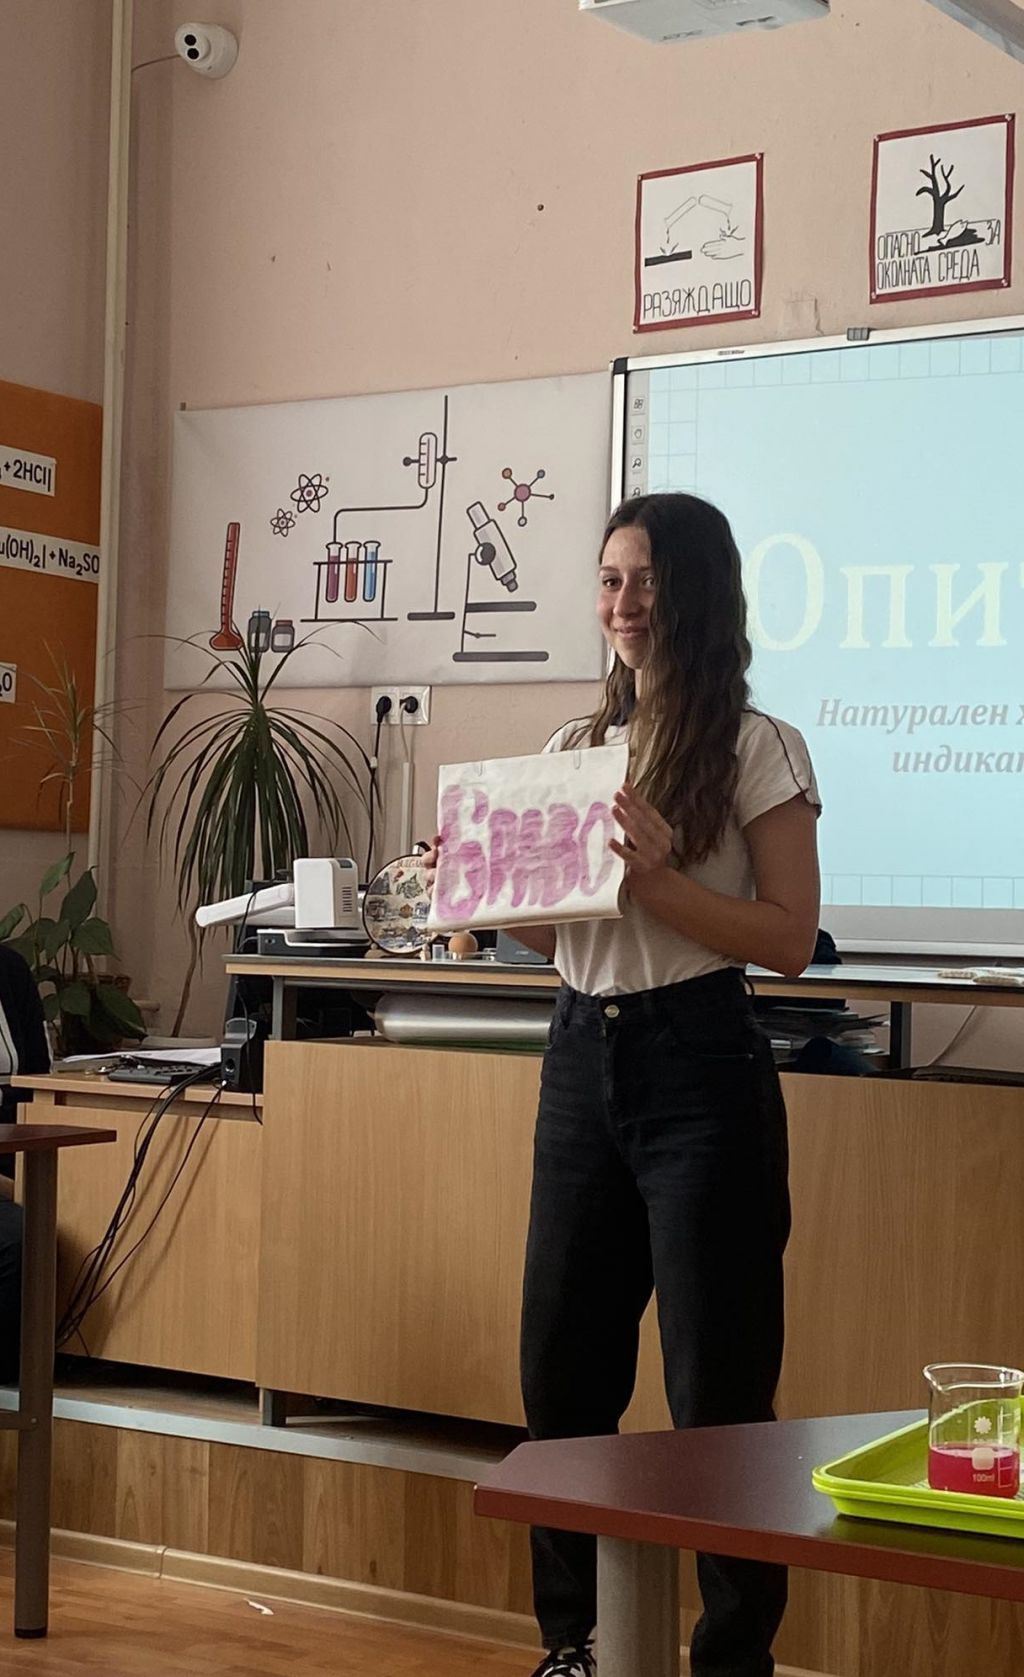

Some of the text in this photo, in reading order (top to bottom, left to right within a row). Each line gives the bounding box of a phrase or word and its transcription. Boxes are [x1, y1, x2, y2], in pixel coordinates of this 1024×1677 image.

[877, 219, 1001, 261] ОПАСНО ЗА
[876, 248, 980, 290] ОКОЛНАТА СРЕДА
[643, 279, 752, 319] РАЗЯЖДАЩО
[816, 699, 1010, 735] Натурален
[892, 745, 1024, 774] индика
